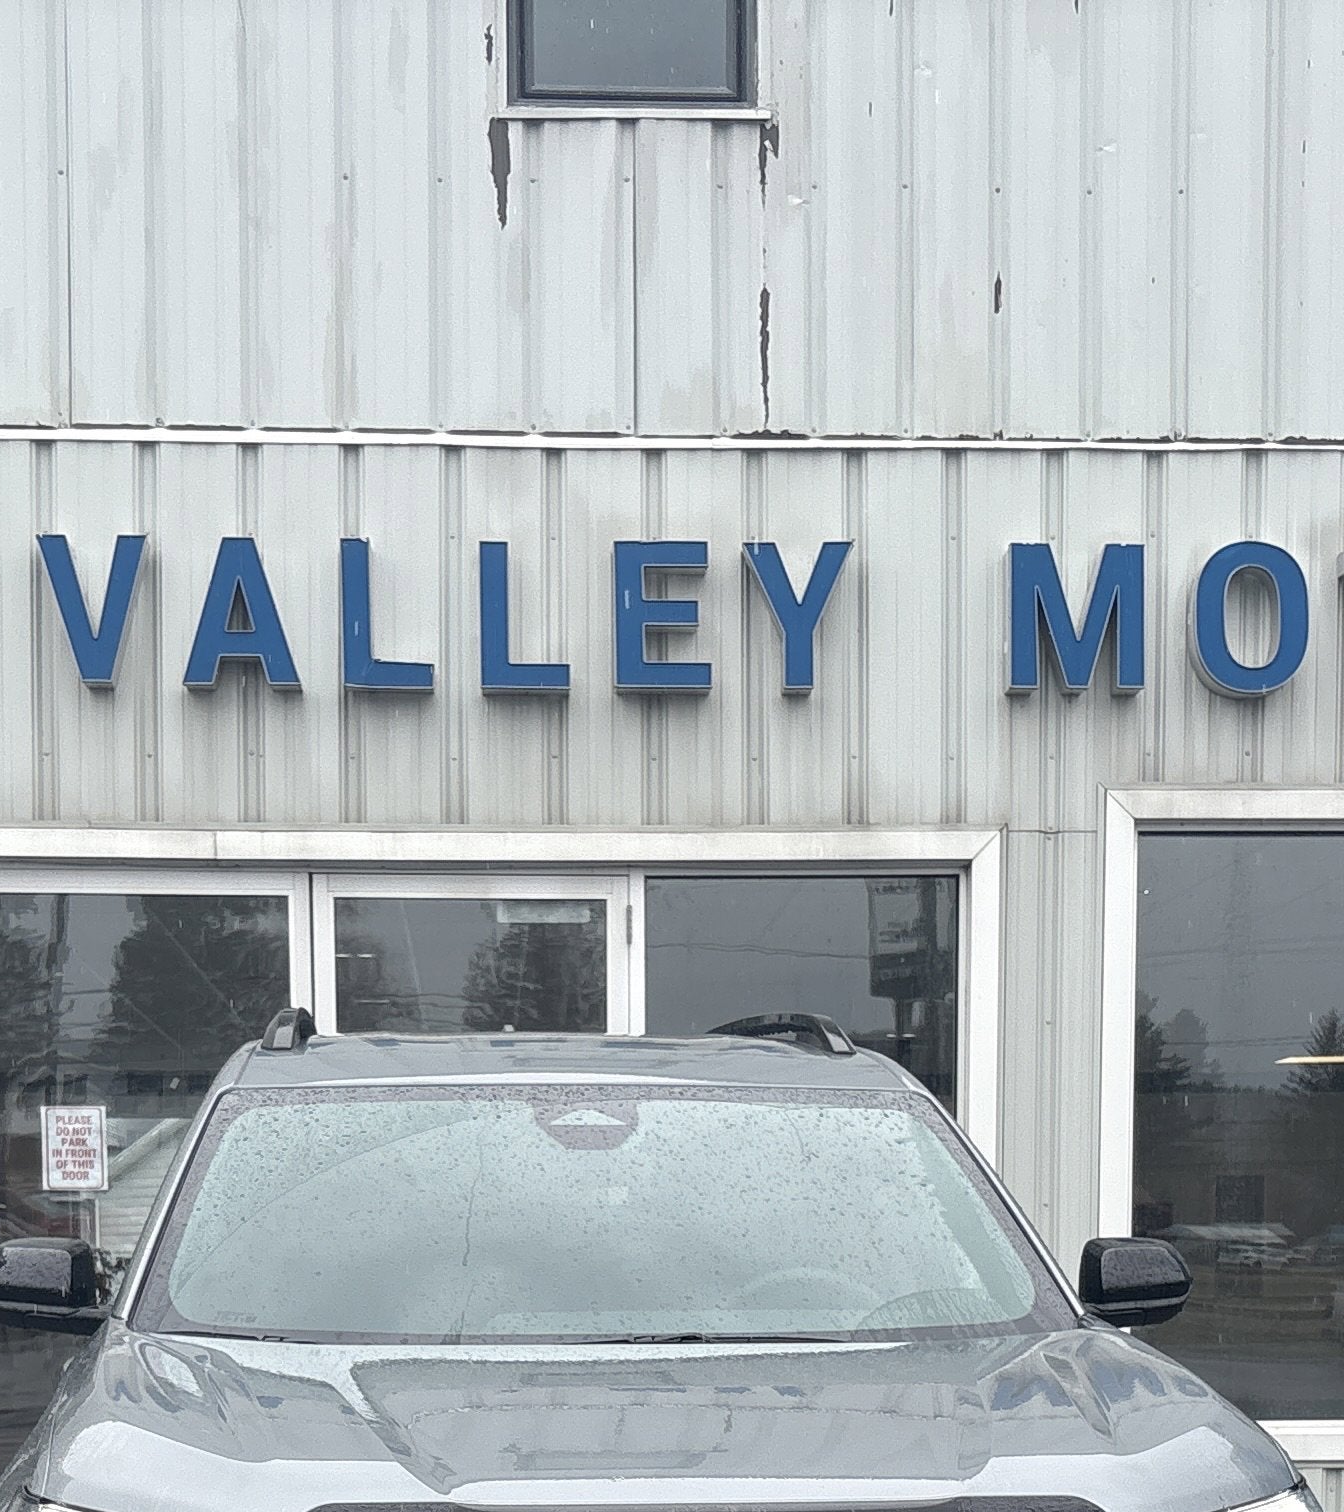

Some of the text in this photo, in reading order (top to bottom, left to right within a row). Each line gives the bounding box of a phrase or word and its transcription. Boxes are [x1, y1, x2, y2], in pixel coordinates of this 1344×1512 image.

[35, 534, 854, 694] VALLEY
[56, 1115, 92, 1125] PLEASE
[56, 1127, 93, 1136] DO NOT
[61, 1138, 88, 1147] PARK
[52, 1149, 97, 1158] IN FRONT
[56, 1160, 95, 1169] OF THIS
[62, 1171, 89, 1180] DOOR
